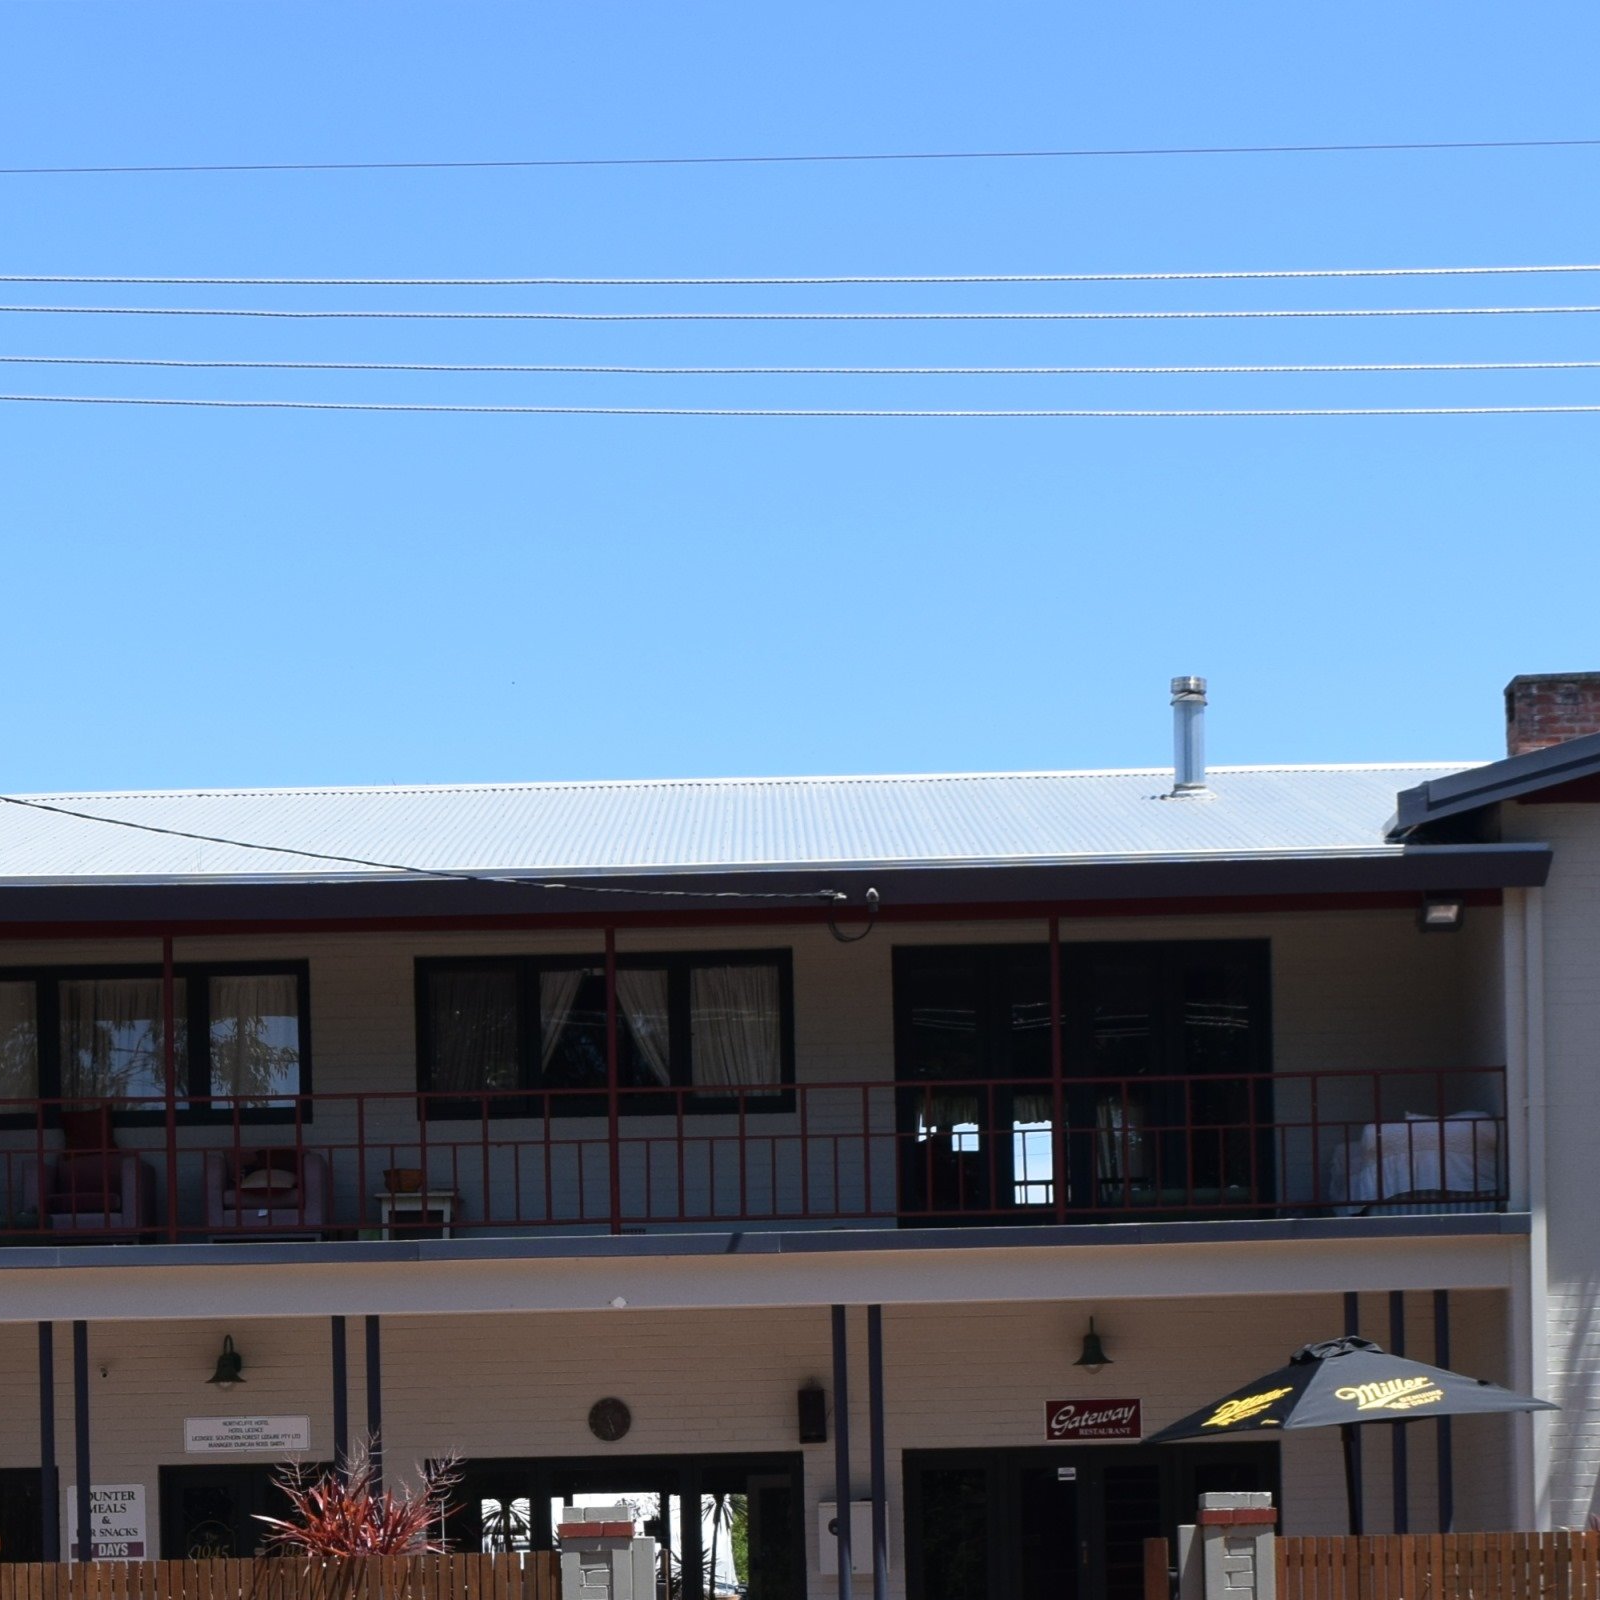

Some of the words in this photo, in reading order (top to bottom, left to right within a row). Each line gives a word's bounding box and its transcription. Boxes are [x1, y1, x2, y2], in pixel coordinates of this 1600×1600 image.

[1335, 1377, 1434, 1410] Miller
[1051, 1405, 1136, 1436] Gateway
[89, 1490, 136, 1501] OUNTER
[101, 1515, 112, 1524] &
[99, 1528, 139, 1537] SNACKS
[98, 1543, 129, 1556] DAYS
